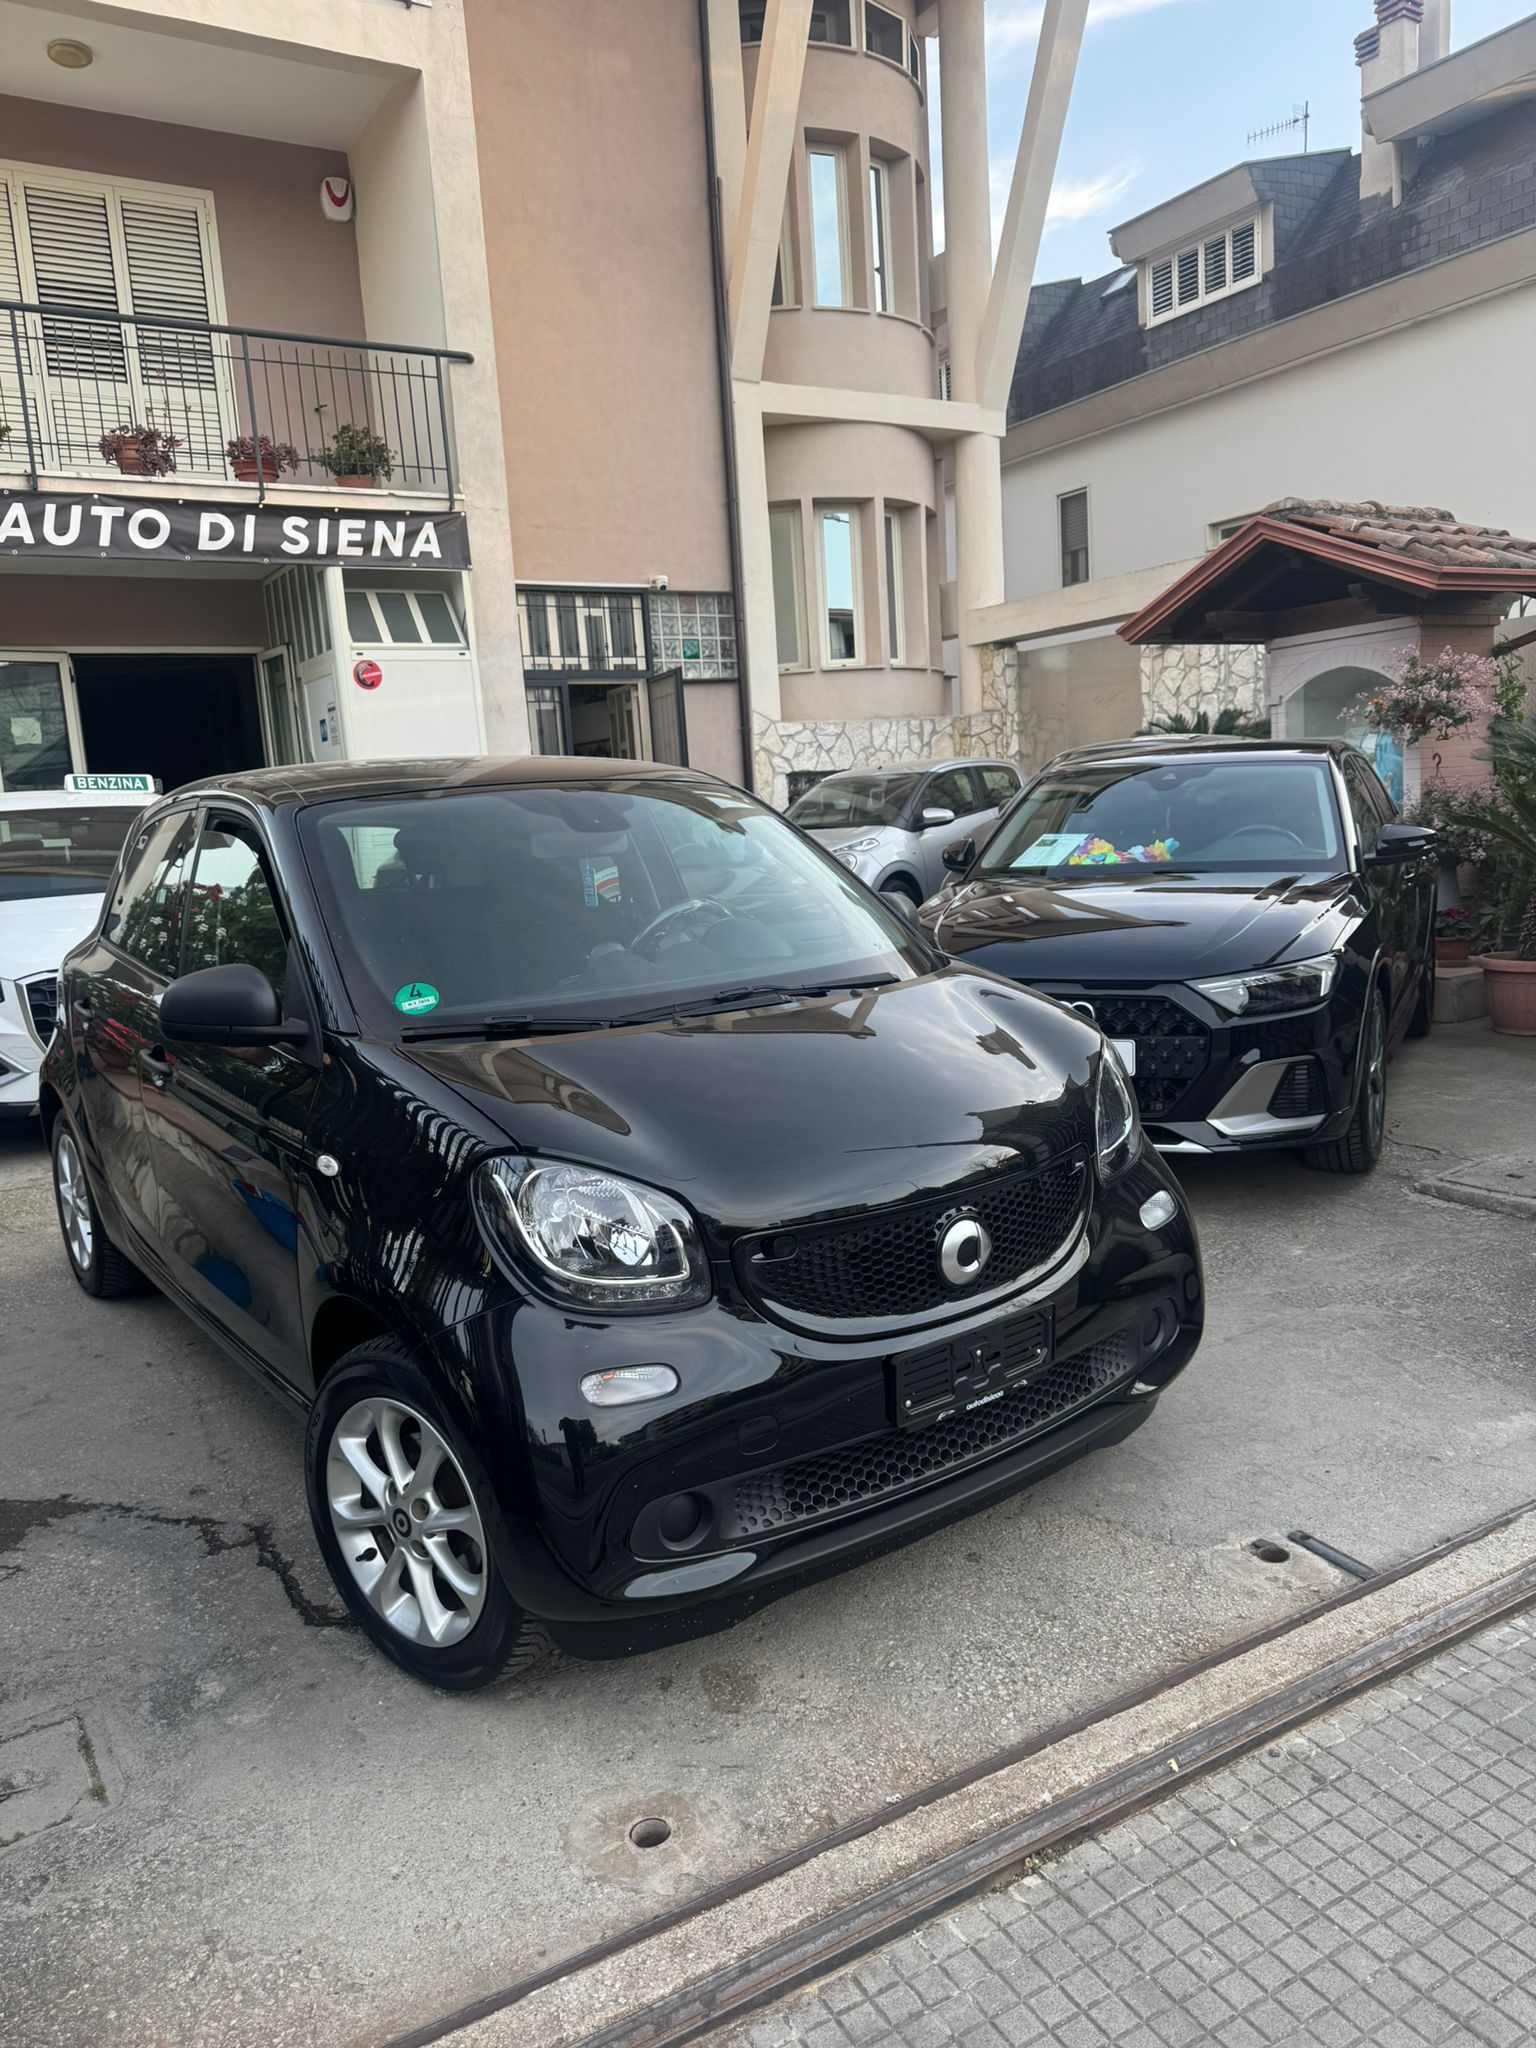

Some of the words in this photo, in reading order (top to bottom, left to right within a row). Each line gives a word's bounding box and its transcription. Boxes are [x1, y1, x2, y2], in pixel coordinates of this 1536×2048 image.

[0, 502, 171, 550] AUTO
[198, 512, 256, 552] DI
[280, 515, 442, 558] SIENA
[76, 776, 144, 789] BENZINA
[410, 983, 423, 998] 4
